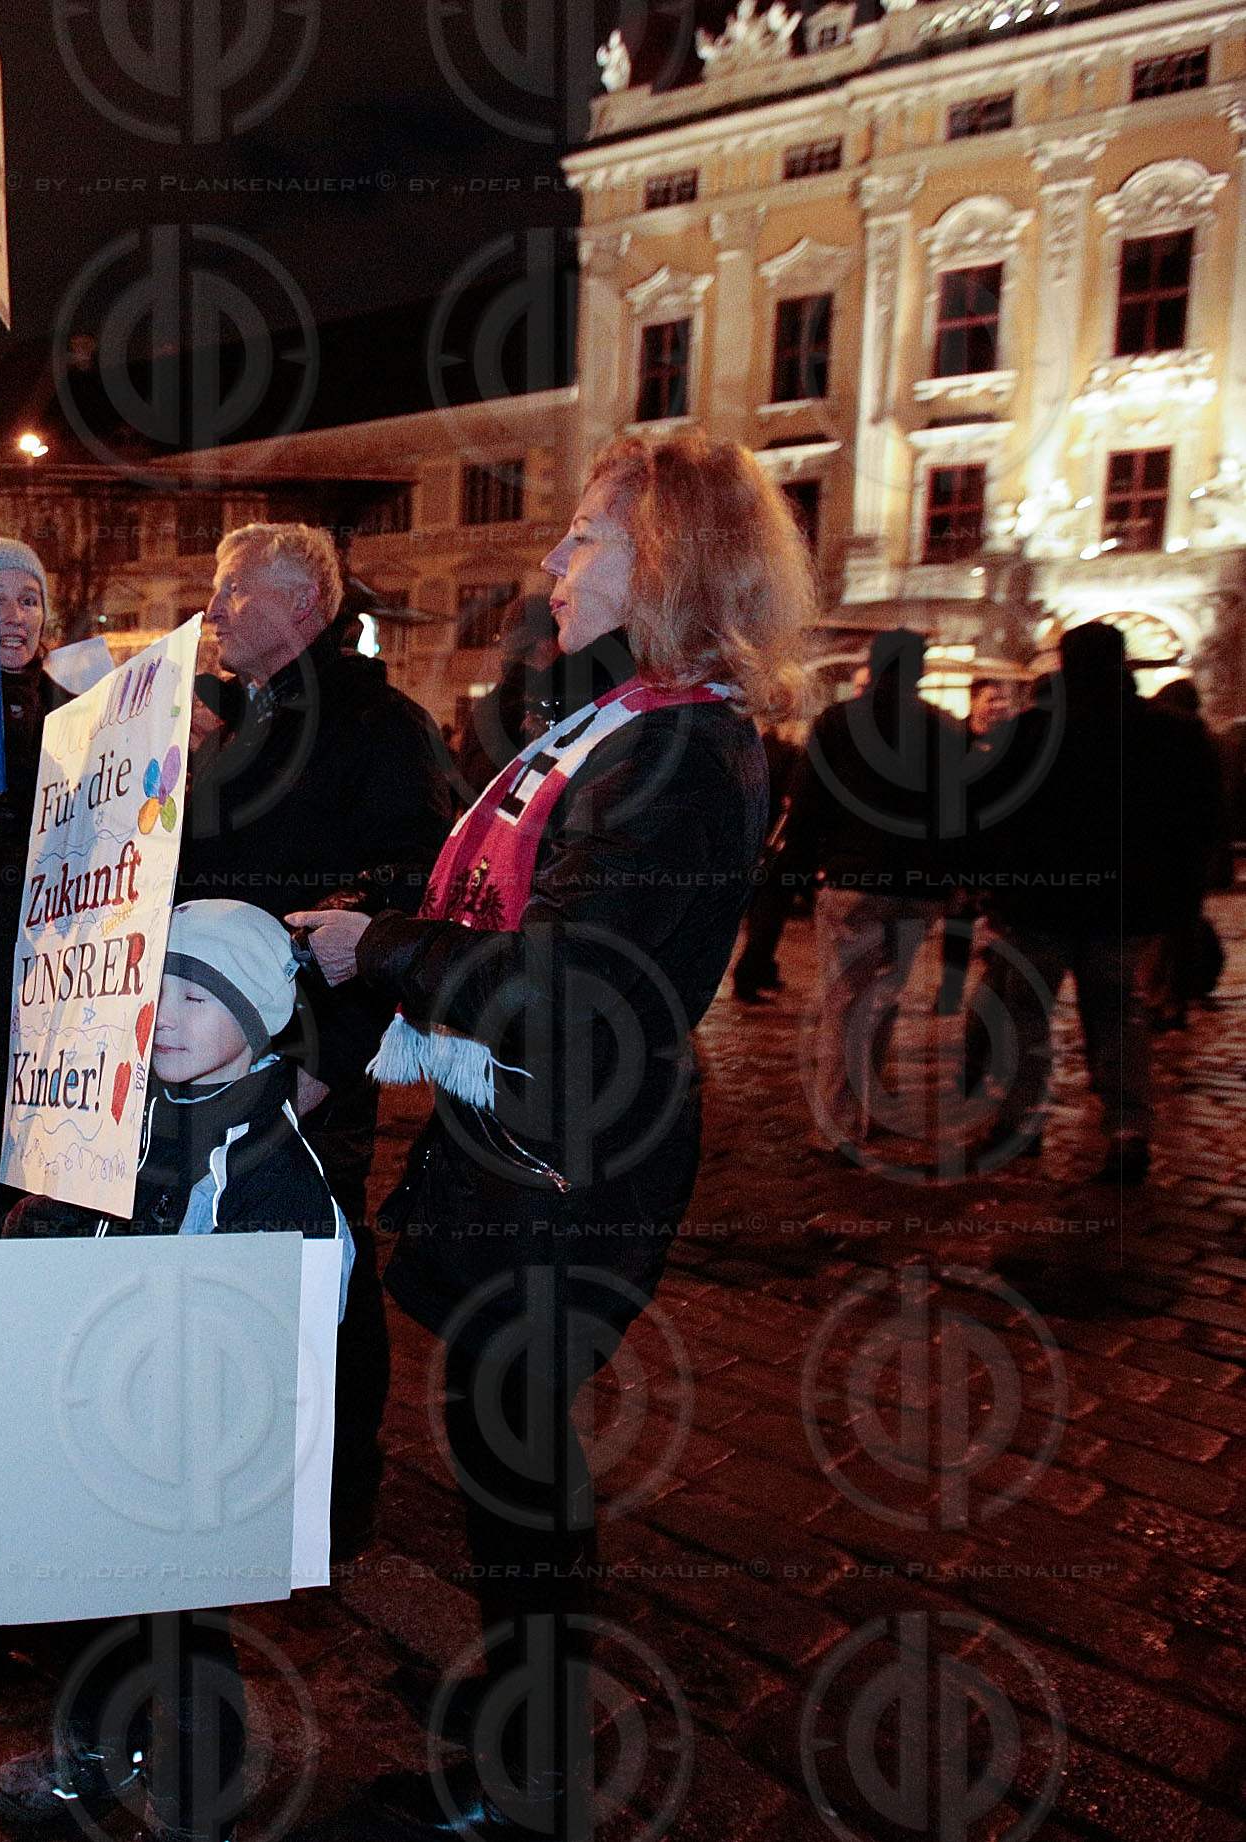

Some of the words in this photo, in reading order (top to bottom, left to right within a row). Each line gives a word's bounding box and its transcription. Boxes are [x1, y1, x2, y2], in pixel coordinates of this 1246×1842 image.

[38, 779, 82, 835] Für
[87, 750, 132, 810] die
[25, 840, 142, 928] Zukunft
[21, 931, 146, 1007] UNSRER
[11, 1049, 105, 1113] Kinder!
